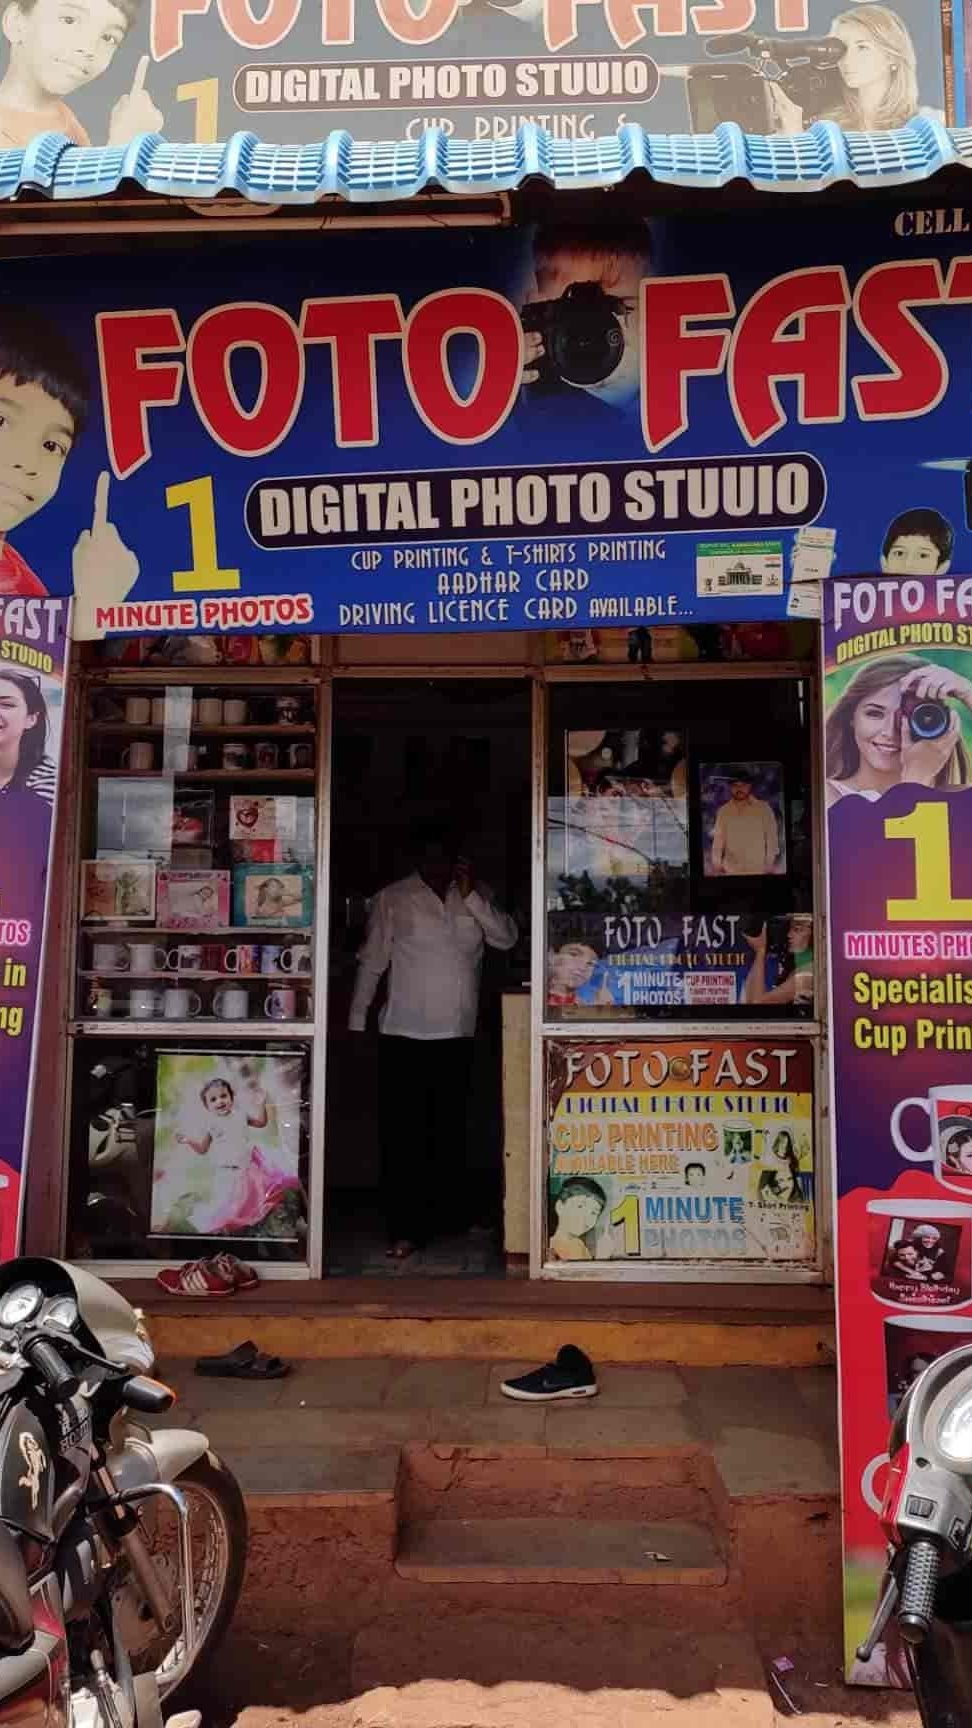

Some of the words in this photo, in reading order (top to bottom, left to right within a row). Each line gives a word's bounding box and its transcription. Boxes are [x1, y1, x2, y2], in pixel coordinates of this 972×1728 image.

[245, 67, 380, 104] DIGITAL
[389, 62, 507, 99] PHOTO
[894, 207, 970, 237] CELL
[95, 287, 523, 480] FOTO
[640, 256, 972, 454] FAS
[259, 481, 439, 537] DIGITAL
[451, 470, 611, 528] PHOTO
[165, 476, 241, 592] 1
[351, 550, 382, 570] CUP
[393, 546, 470, 569] PRINTING
[481, 546, 493, 567] &
[506, 543, 577, 565] T-SHIRTS
[588, 540, 666, 562] PRINTING
[437, 571, 521, 595] AADHAR
[535, 568, 589, 592] CARD
[95, 603, 195, 629] MINUTE
[203, 598, 311, 626] PHOTOS
[339, 602, 415, 626] DRIVING
[428, 598, 509, 624] LICENCE
[524, 596, 577, 620] CARD
[589, 595, 693, 618] AVAILABLE...
[833, 579, 925, 633] FOTO
[1, 639, 53, 673] STUDIO
[836, 626, 897, 664] DIGITAL
[899, 622, 953, 645] PHOTO
[884, 801, 972, 921] 1
[604, 915, 662, 949] FOTO
[682, 915, 740, 949] FAST
[847, 932, 937, 959] MINUTES
[941, 932, 972, 958] PH
[3, 957, 27, 987] in
[633, 971, 683, 988] MINUTE
[632, 990, 684, 1006] PHOTOS
[854, 1017, 907, 1056] Cup
[916, 1018, 972, 1051] Prin
[565, 1049, 670, 1088] FOTO
[688, 1048, 798, 1088] FAST
[552, 1122, 602, 1152] CUP
[606, 1121, 720, 1152] PRINTING
[610, 1194, 642, 1257] 1
[645, 1195, 745, 1225] MINUTE
